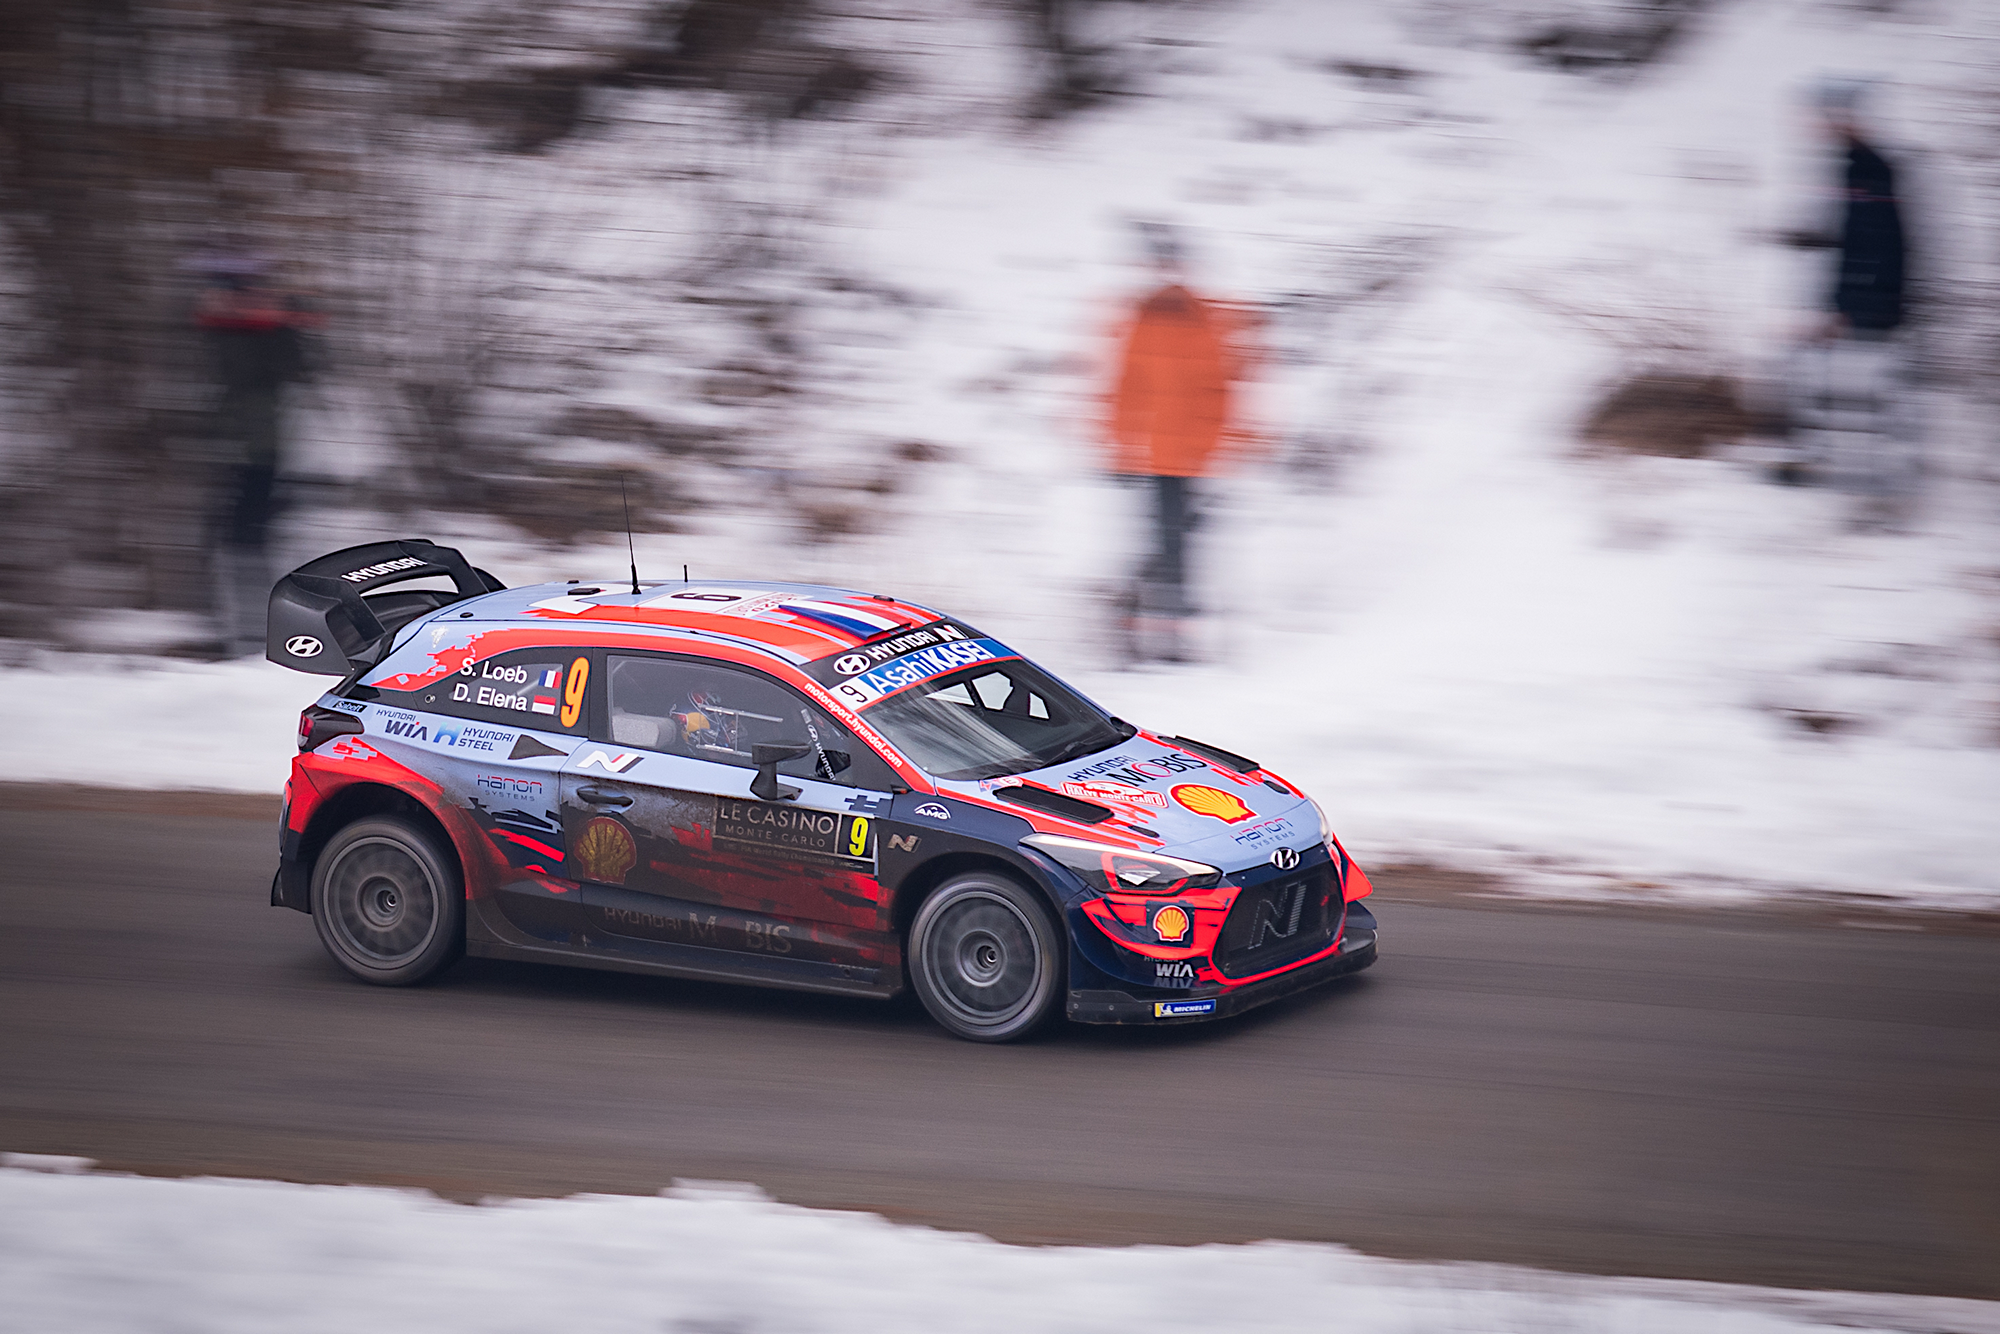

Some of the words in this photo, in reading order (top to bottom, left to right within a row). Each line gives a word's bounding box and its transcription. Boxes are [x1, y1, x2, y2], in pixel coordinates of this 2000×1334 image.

[341, 556, 428, 582] HYUNDAI
[865, 630, 939, 661] HYUNDAI
[460, 657, 477, 677] S.
[481, 660, 528, 684] Loeb
[452, 682, 471, 703] D.
[476, 686, 527, 711] Elena
[560, 656, 590, 728] 9
[376, 709, 416, 721] HYUNDAI
[803, 682, 904, 768] motorsport.hyundai.com
[384, 719, 428, 741] WIA
[462, 727, 516, 742] HYUNDAI
[457, 738, 494, 752] STEEL
[815, 742, 837, 781] HYUNDAI
[1067, 754, 1139, 782] HYUNDAI
[1105, 753, 1208, 787] MOBIS
[484, 789, 536, 802] SYSTEMS
[720, 801, 742, 822] LE
[747, 805, 834, 835] CASINO
[914, 807, 949, 820] AMG
[848, 816, 869, 857] 9
[1250, 831, 1296, 850] SYSTEMS
[1155, 960, 1195, 978] WIA
[1173, 1004, 1212, 1013] MICHELIN
